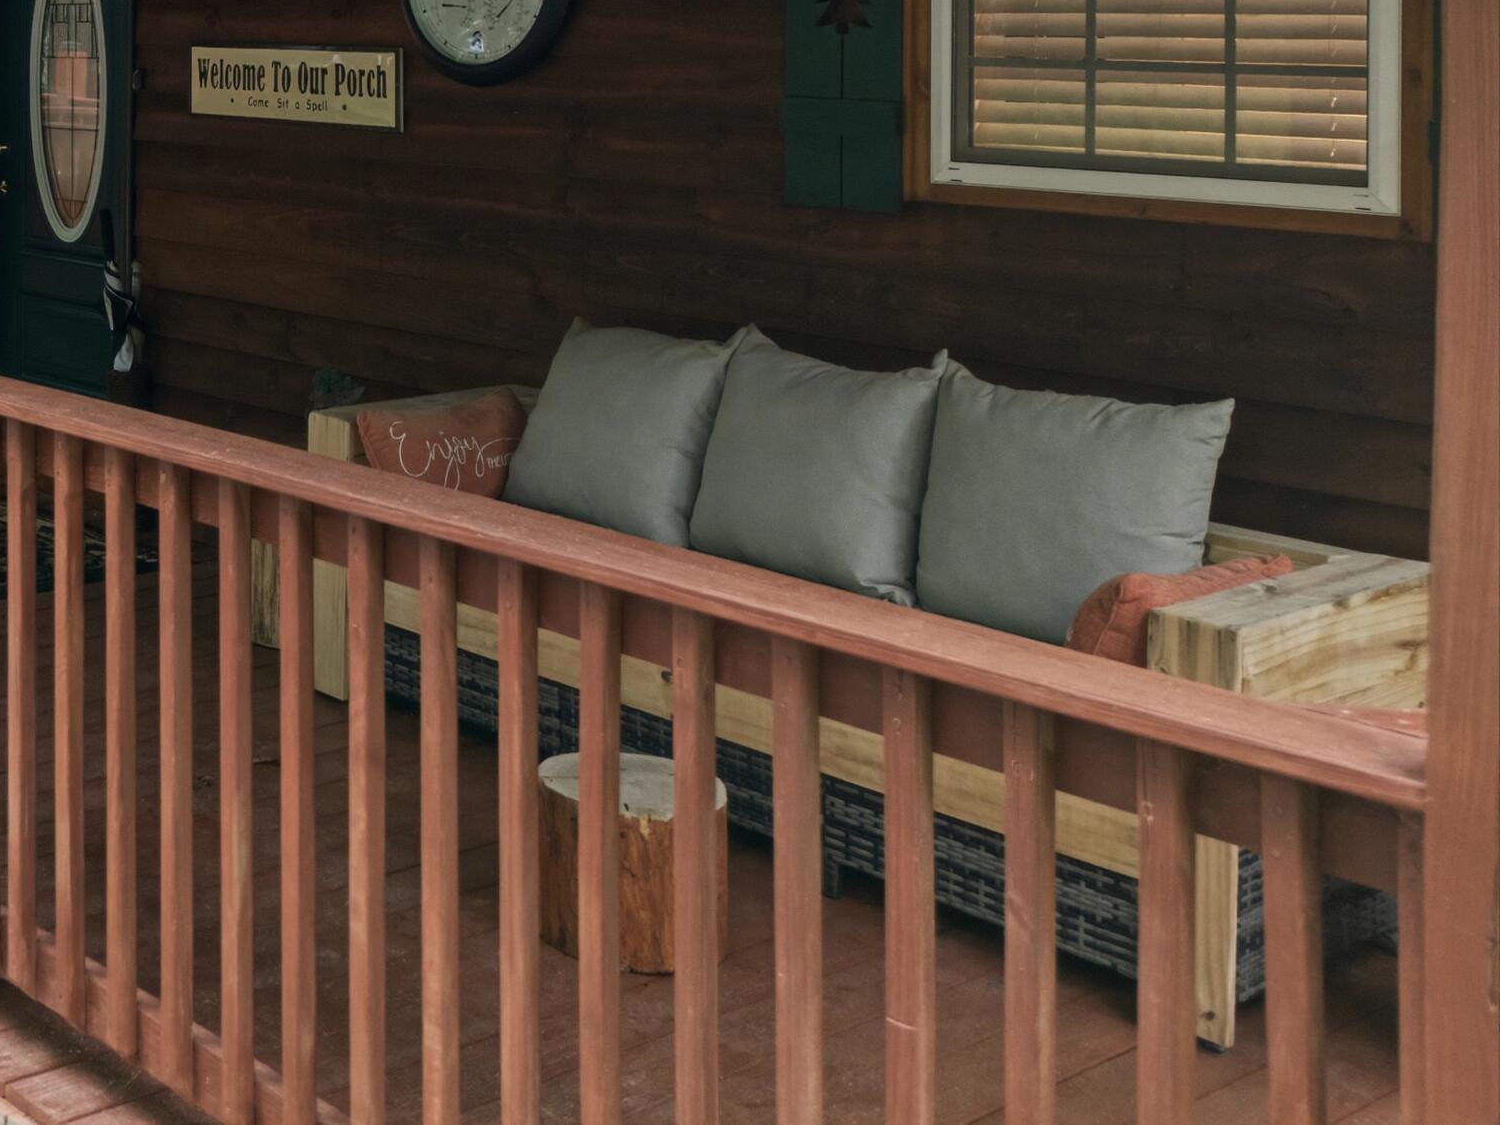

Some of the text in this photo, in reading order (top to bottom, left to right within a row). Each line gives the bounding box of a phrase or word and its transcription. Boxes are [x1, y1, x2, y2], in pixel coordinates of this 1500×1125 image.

[197, 58, 388, 99] Welcome To Our Porch
[247, 96, 329, 112] Come Sit a Spell
[390, 421, 520, 491] Enjoy
